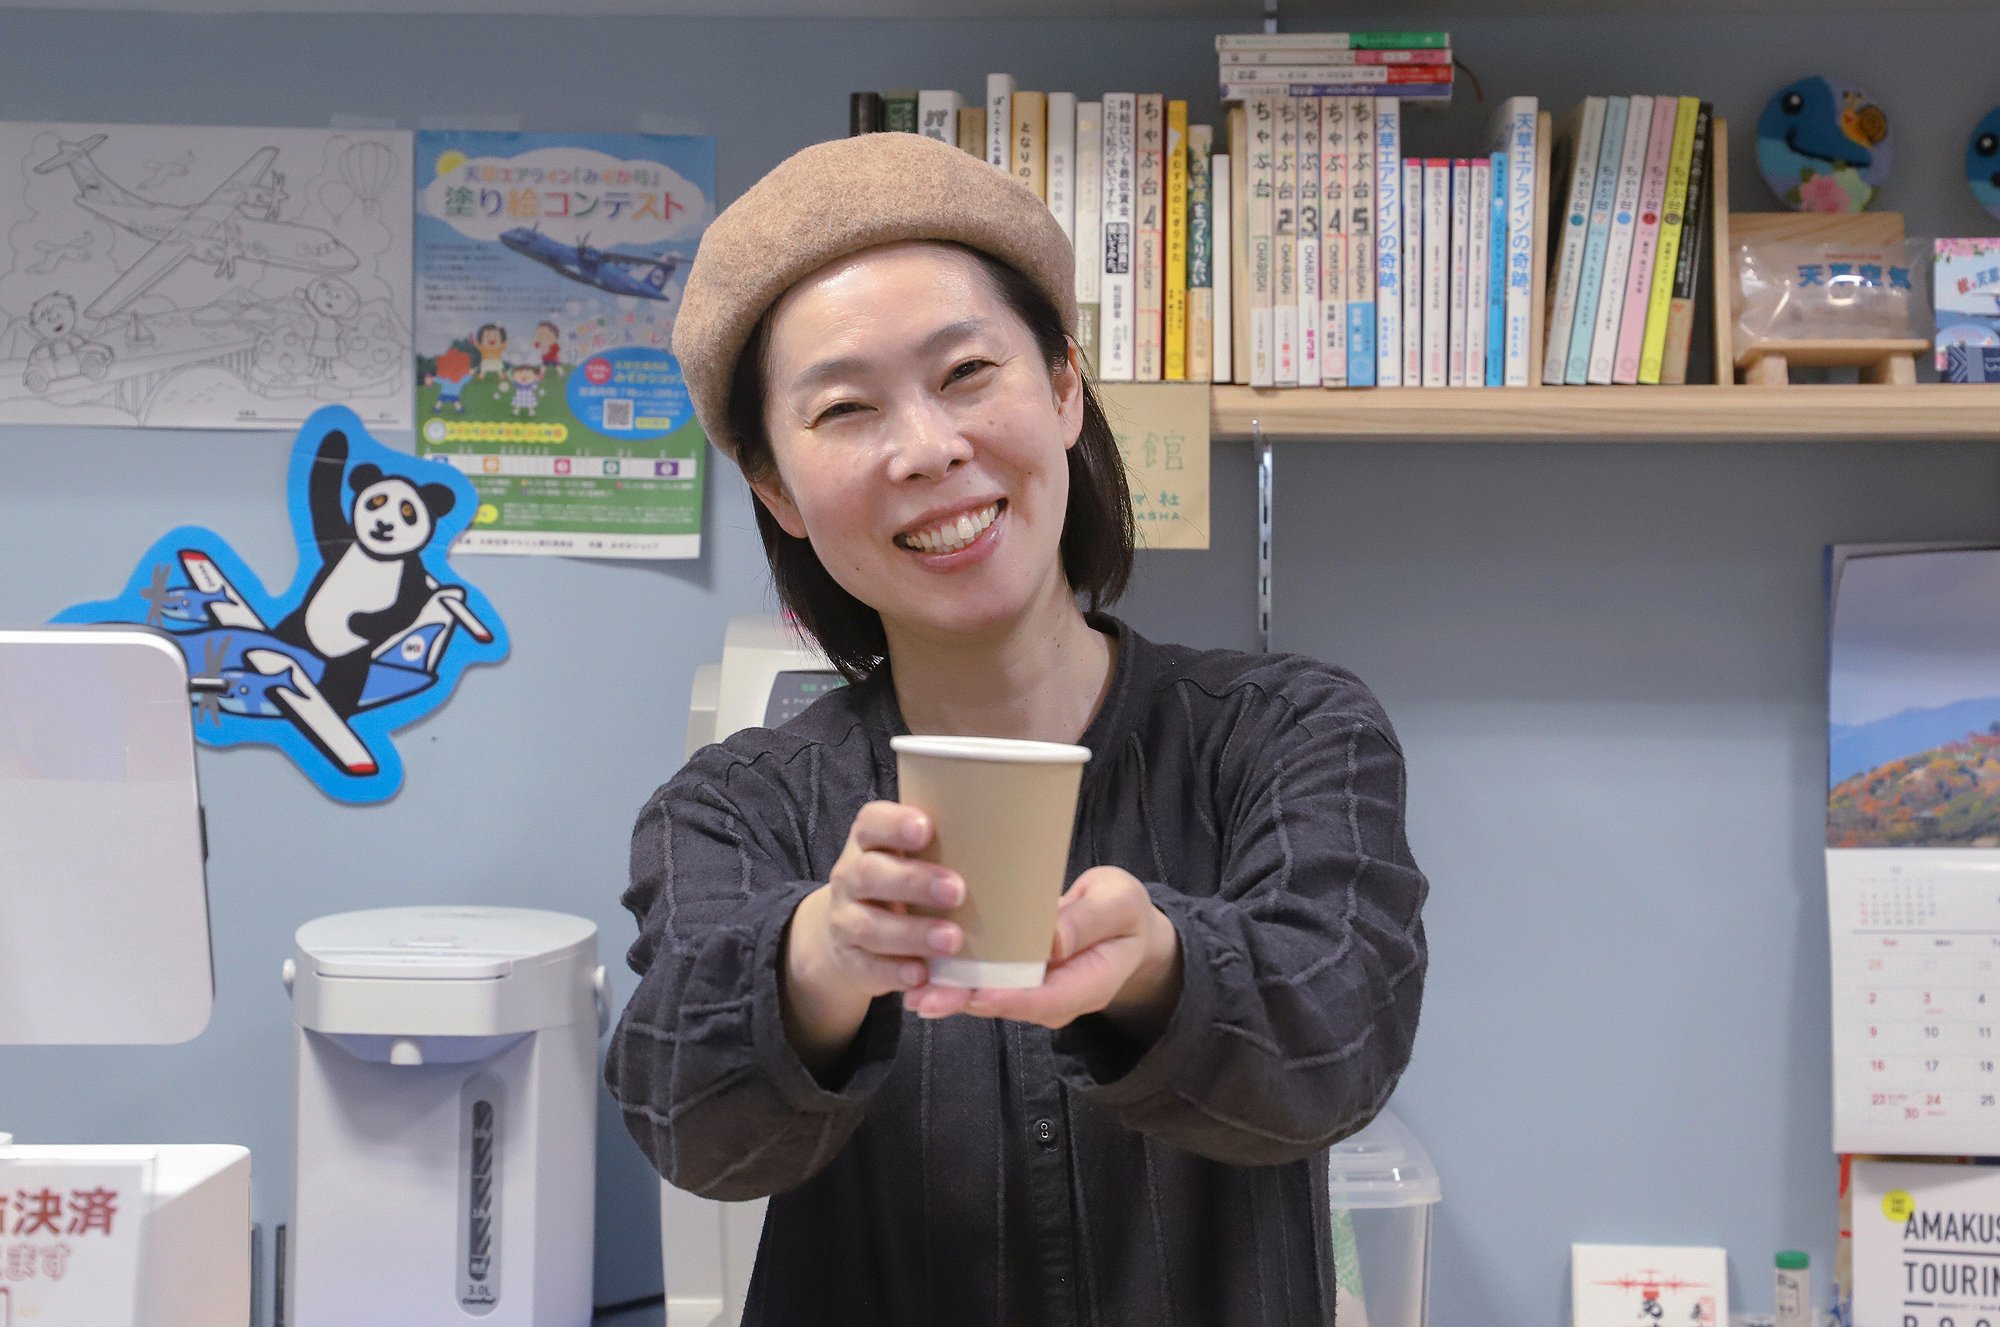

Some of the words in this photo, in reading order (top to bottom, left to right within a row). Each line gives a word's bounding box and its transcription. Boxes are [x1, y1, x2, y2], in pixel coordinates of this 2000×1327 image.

[1018, 122, 1032, 185] となりの
[1253, 102, 1271, 198] ちゃぶ台
[445, 186, 685, 220] 塗り絵コンテスト
[1378, 113, 1399, 296] 天草エアラインの奇跡。
[1511, 113, 1534, 296] 天草エアラインの奇跡。
[1924, 992, 1931, 1004] 3
[1924, 1027, 1939, 1038] 10
[1979, 1027, 1991, 1038] 11
[1871, 1060, 1885, 1072] 16
[1924, 1060, 1939, 1072] 17
[1980, 1061, 1993, 1072] 18
[1871, 1093, 1887, 1106] 23
[1925, 1094, 1941, 1106] 24
[1980, 1094, 1995, 1107] 25
[1904, 1108, 1919, 1120] 30
[0, 1187, 117, 1235] 決済
[467, 1285, 491, 1296] 3.0L
